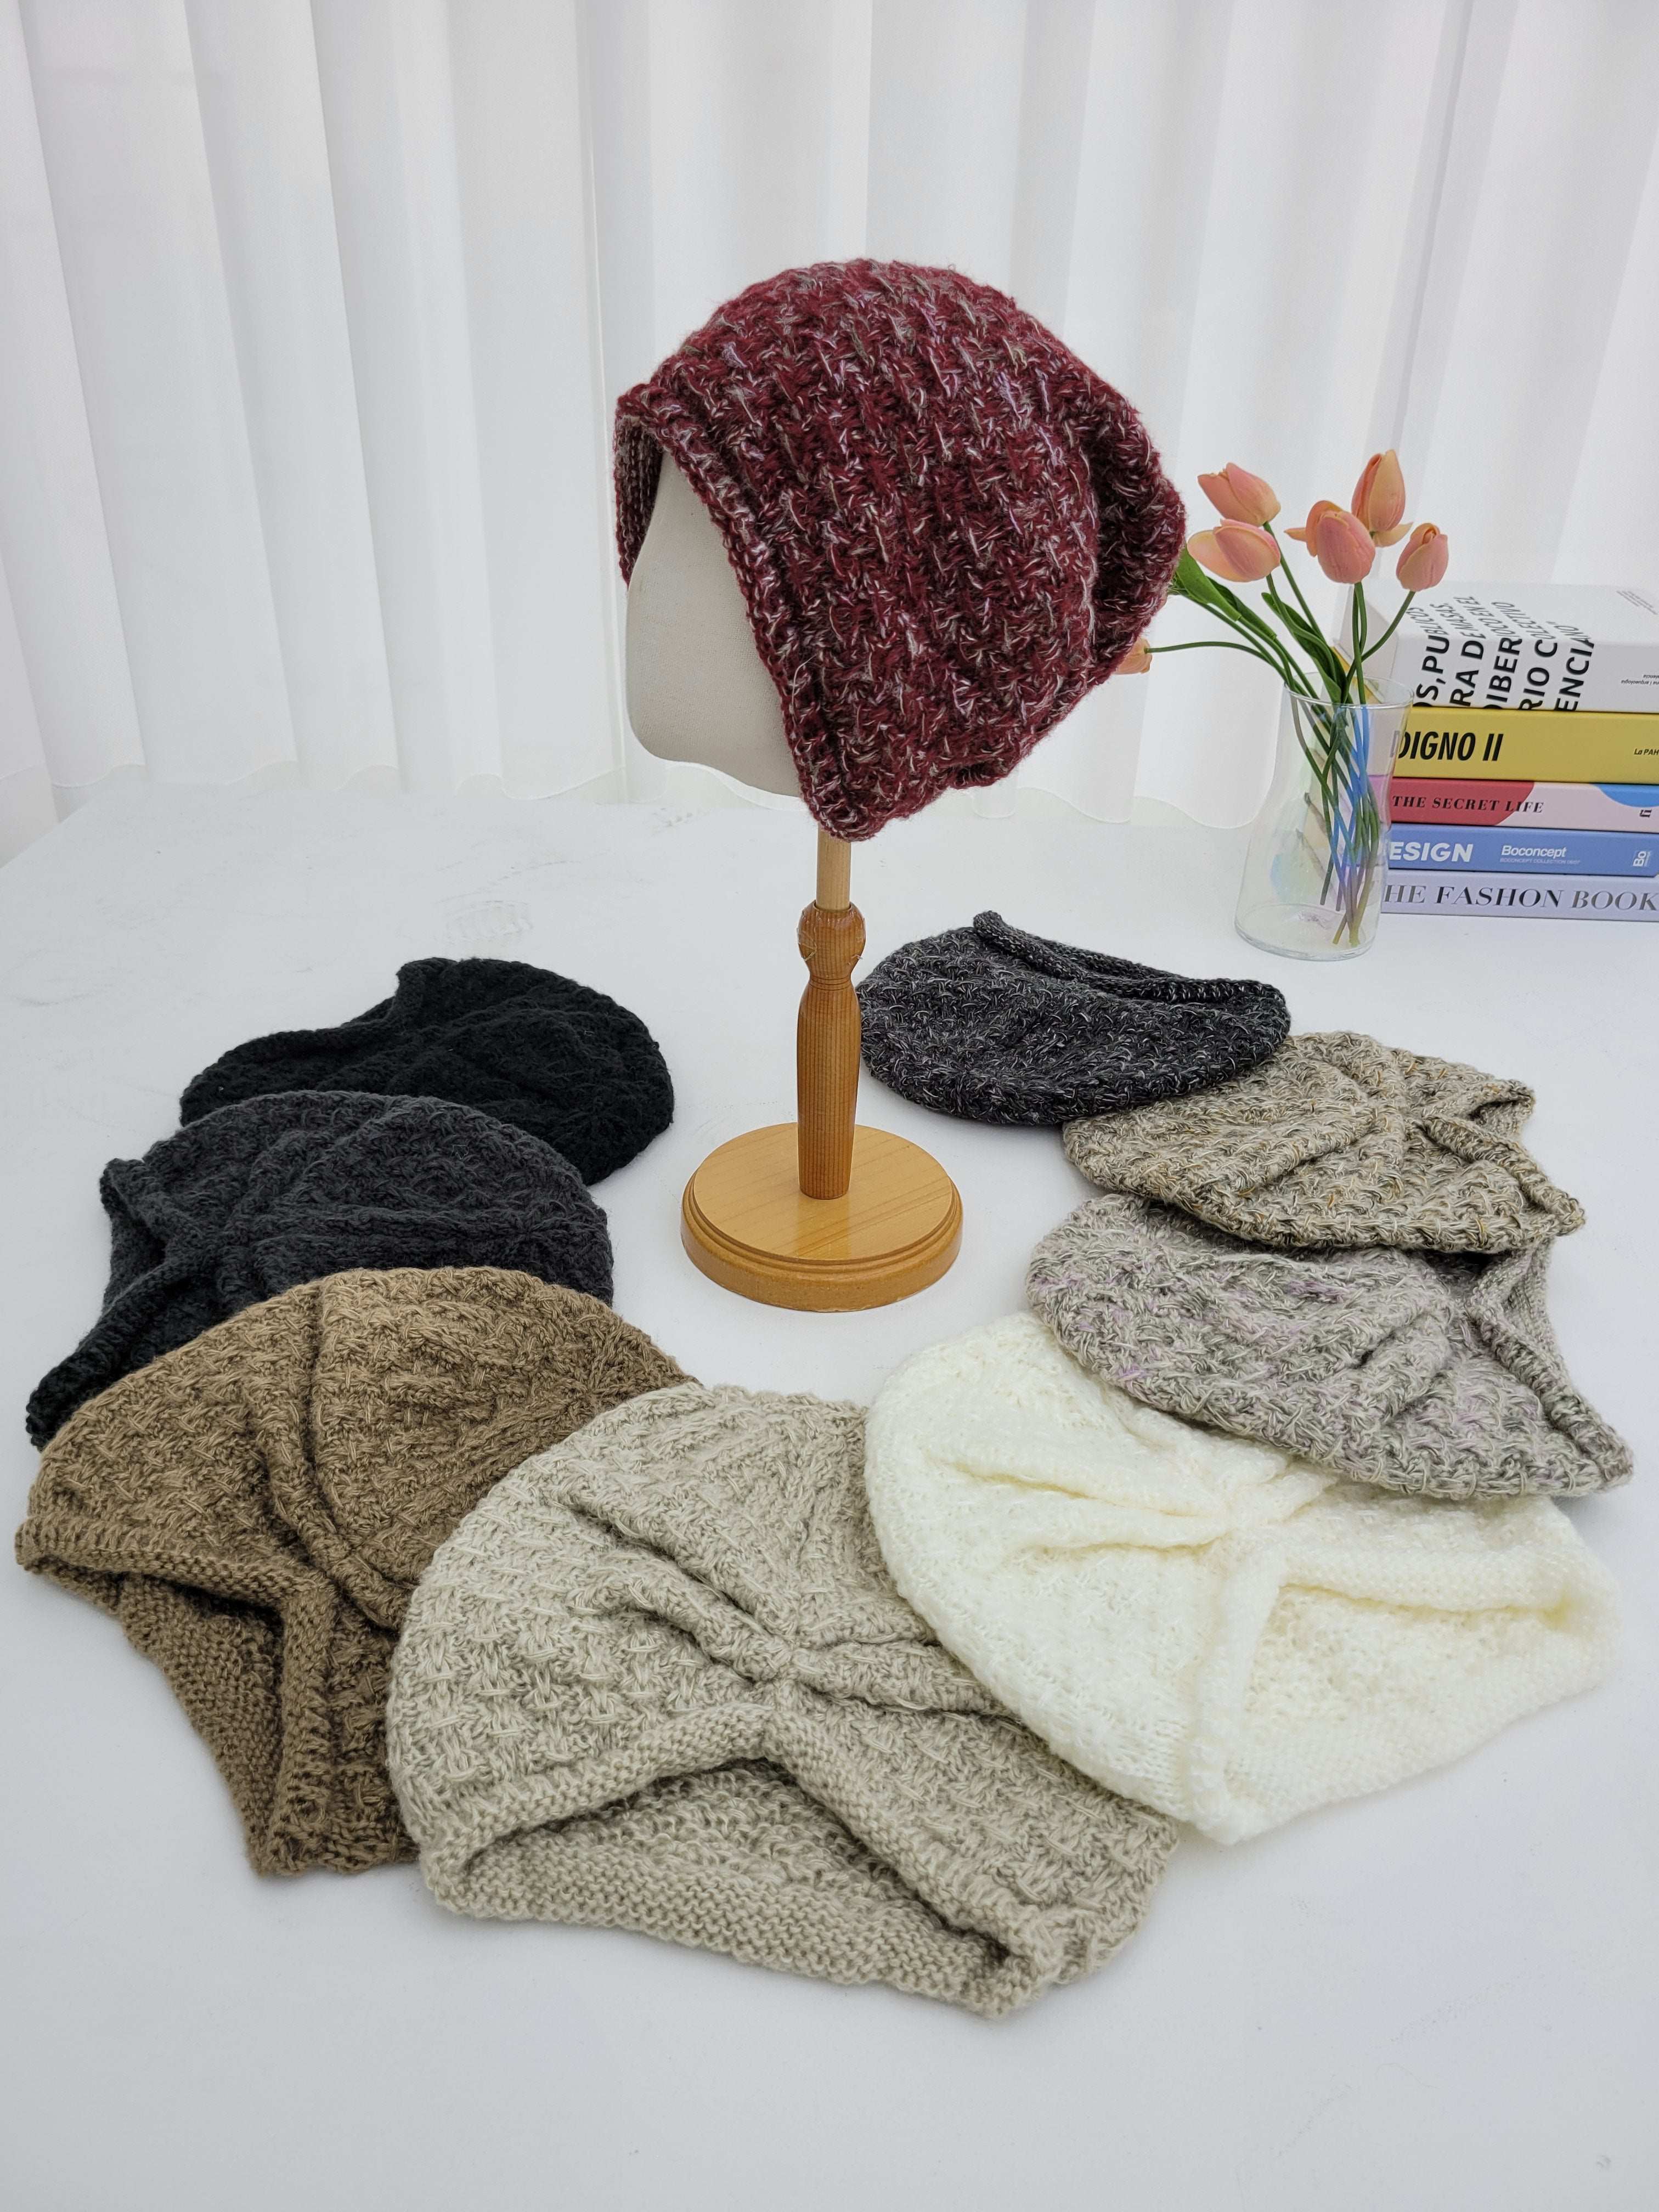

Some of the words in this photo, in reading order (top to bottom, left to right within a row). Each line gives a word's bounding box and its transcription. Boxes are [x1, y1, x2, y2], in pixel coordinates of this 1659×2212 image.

[1482, 733, 1504, 761] II
[1392, 795, 1426, 808] THE
[1432, 797, 1499, 811] SECRET
[1505, 800, 1545, 813] LIFE
[1389, 842, 1474, 862] ESIGN
[1501, 845, 1567, 859] Boconcept
[1383, 884, 1426, 904] HE
[1434, 885, 1565, 908] FASHON
[1569, 890, 1659, 911] BOOK
